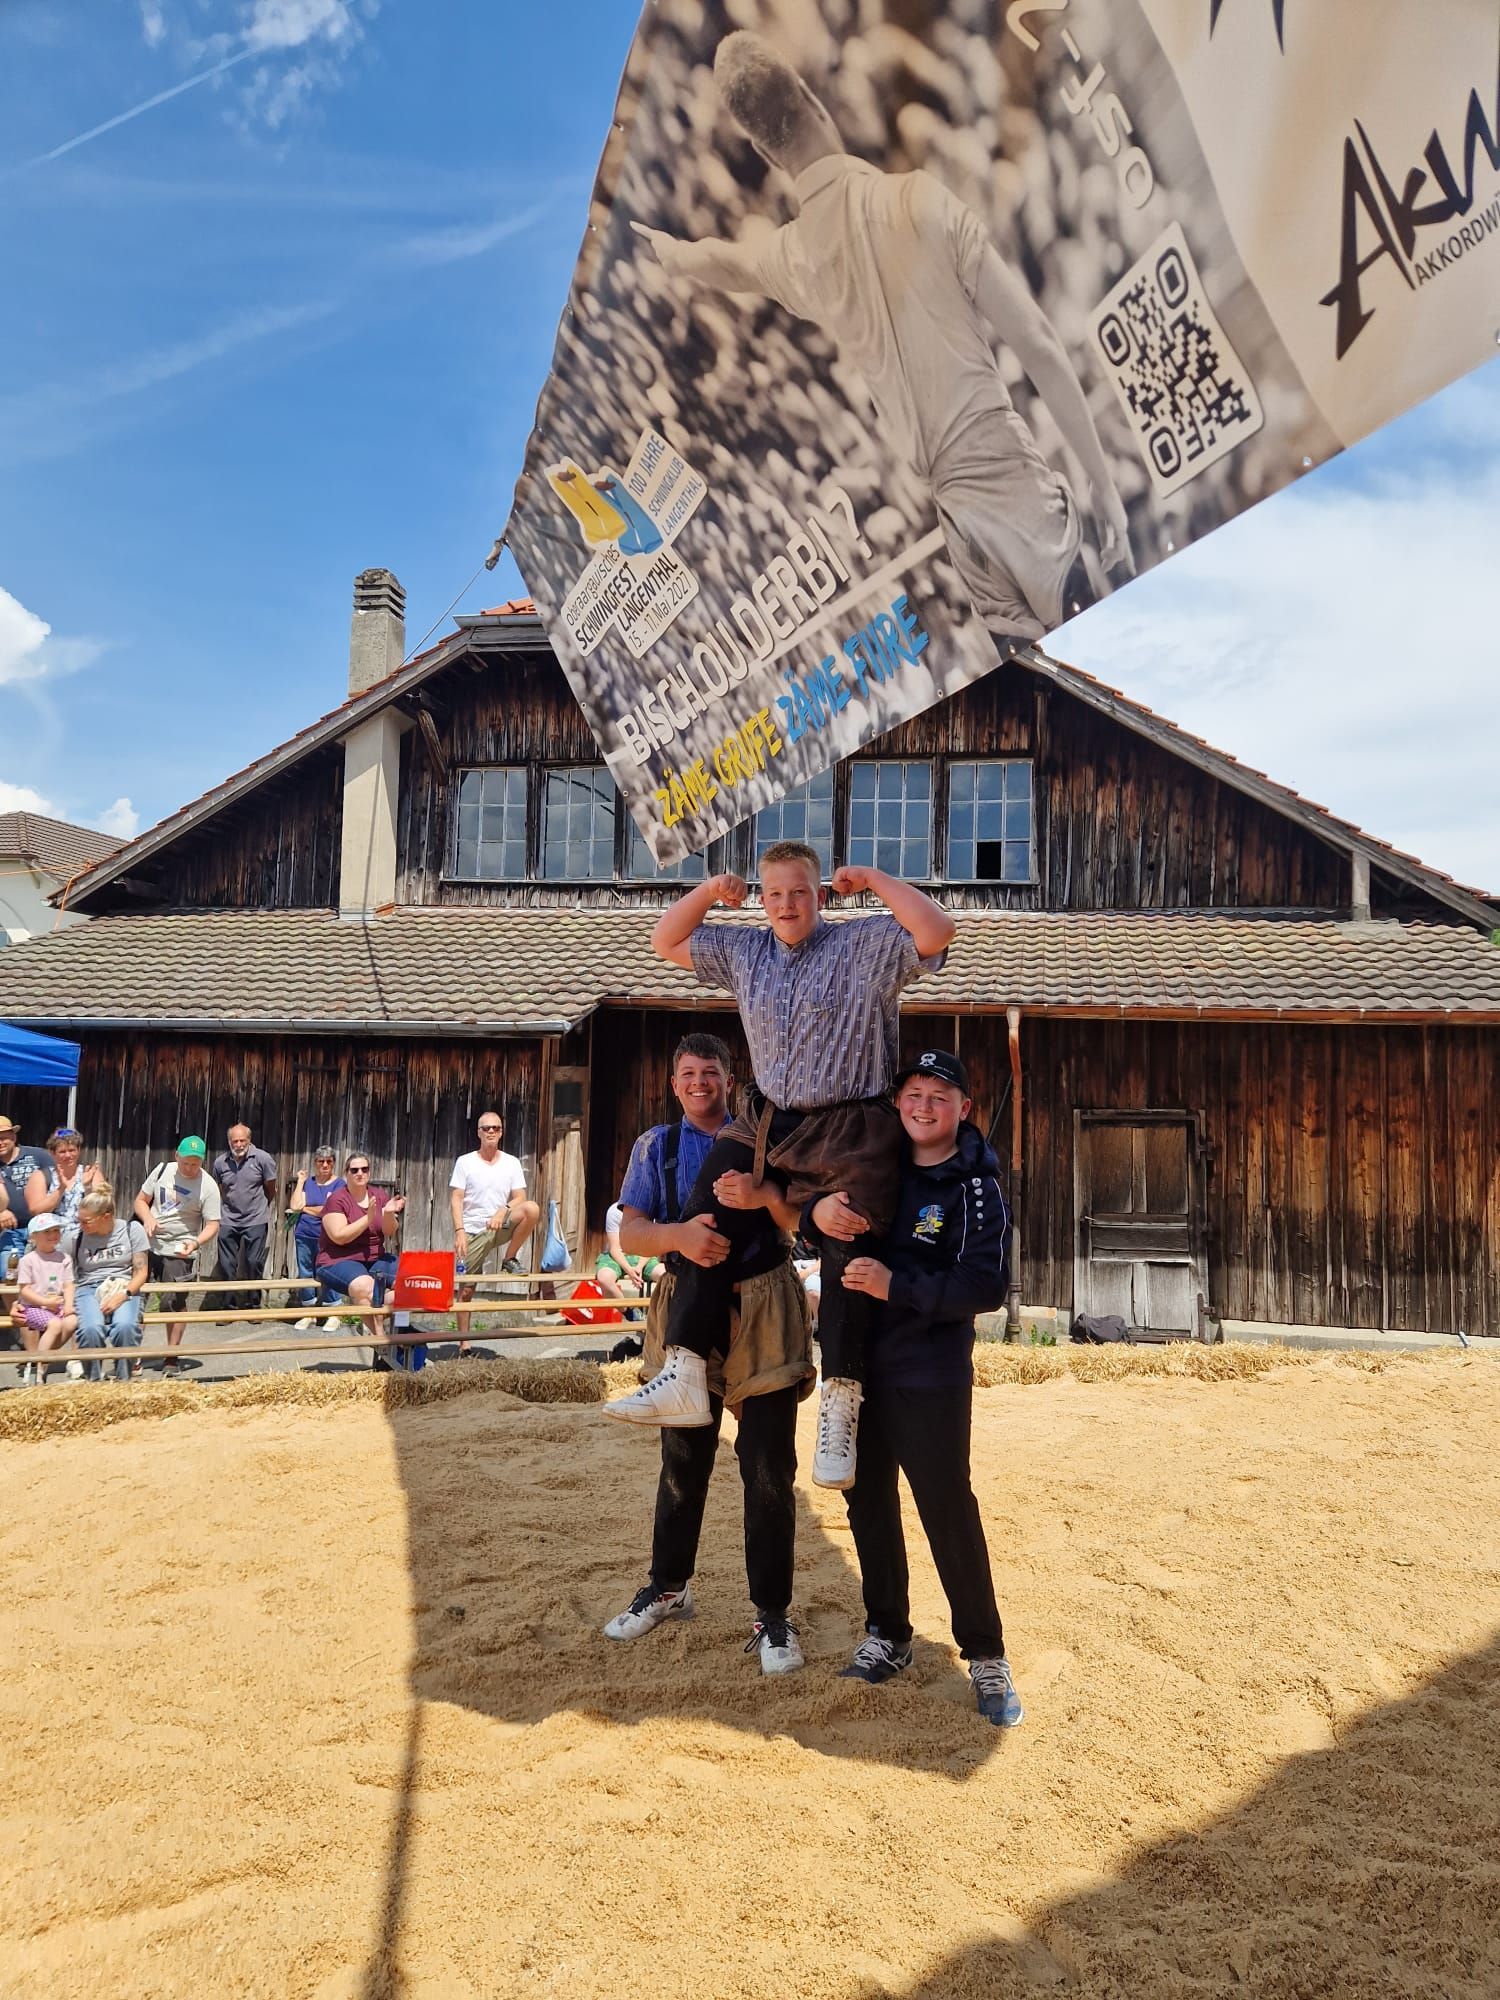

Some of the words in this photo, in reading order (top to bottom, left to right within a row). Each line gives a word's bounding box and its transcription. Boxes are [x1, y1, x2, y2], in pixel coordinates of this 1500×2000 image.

[629, 472, 648, 497] 100
[638, 434, 666, 478] JAHRE
[648, 456, 685, 517] SCHWINGKLUB
[662, 476, 702, 537] LANGENTHAL
[566, 544, 620, 626] oberaargauisches
[575, 561, 637, 650] SCHWINGFEST
[617, 552, 679, 632] LANGENTHAL
[667, 571, 692, 607] 2027
[615, 662, 709, 767] BISCH
[693, 619, 749, 698] OU
[655, 758, 718, 828] ZÄME
[776, 655, 851, 744] ZÄME
[843, 594, 929, 699] FIIRE
